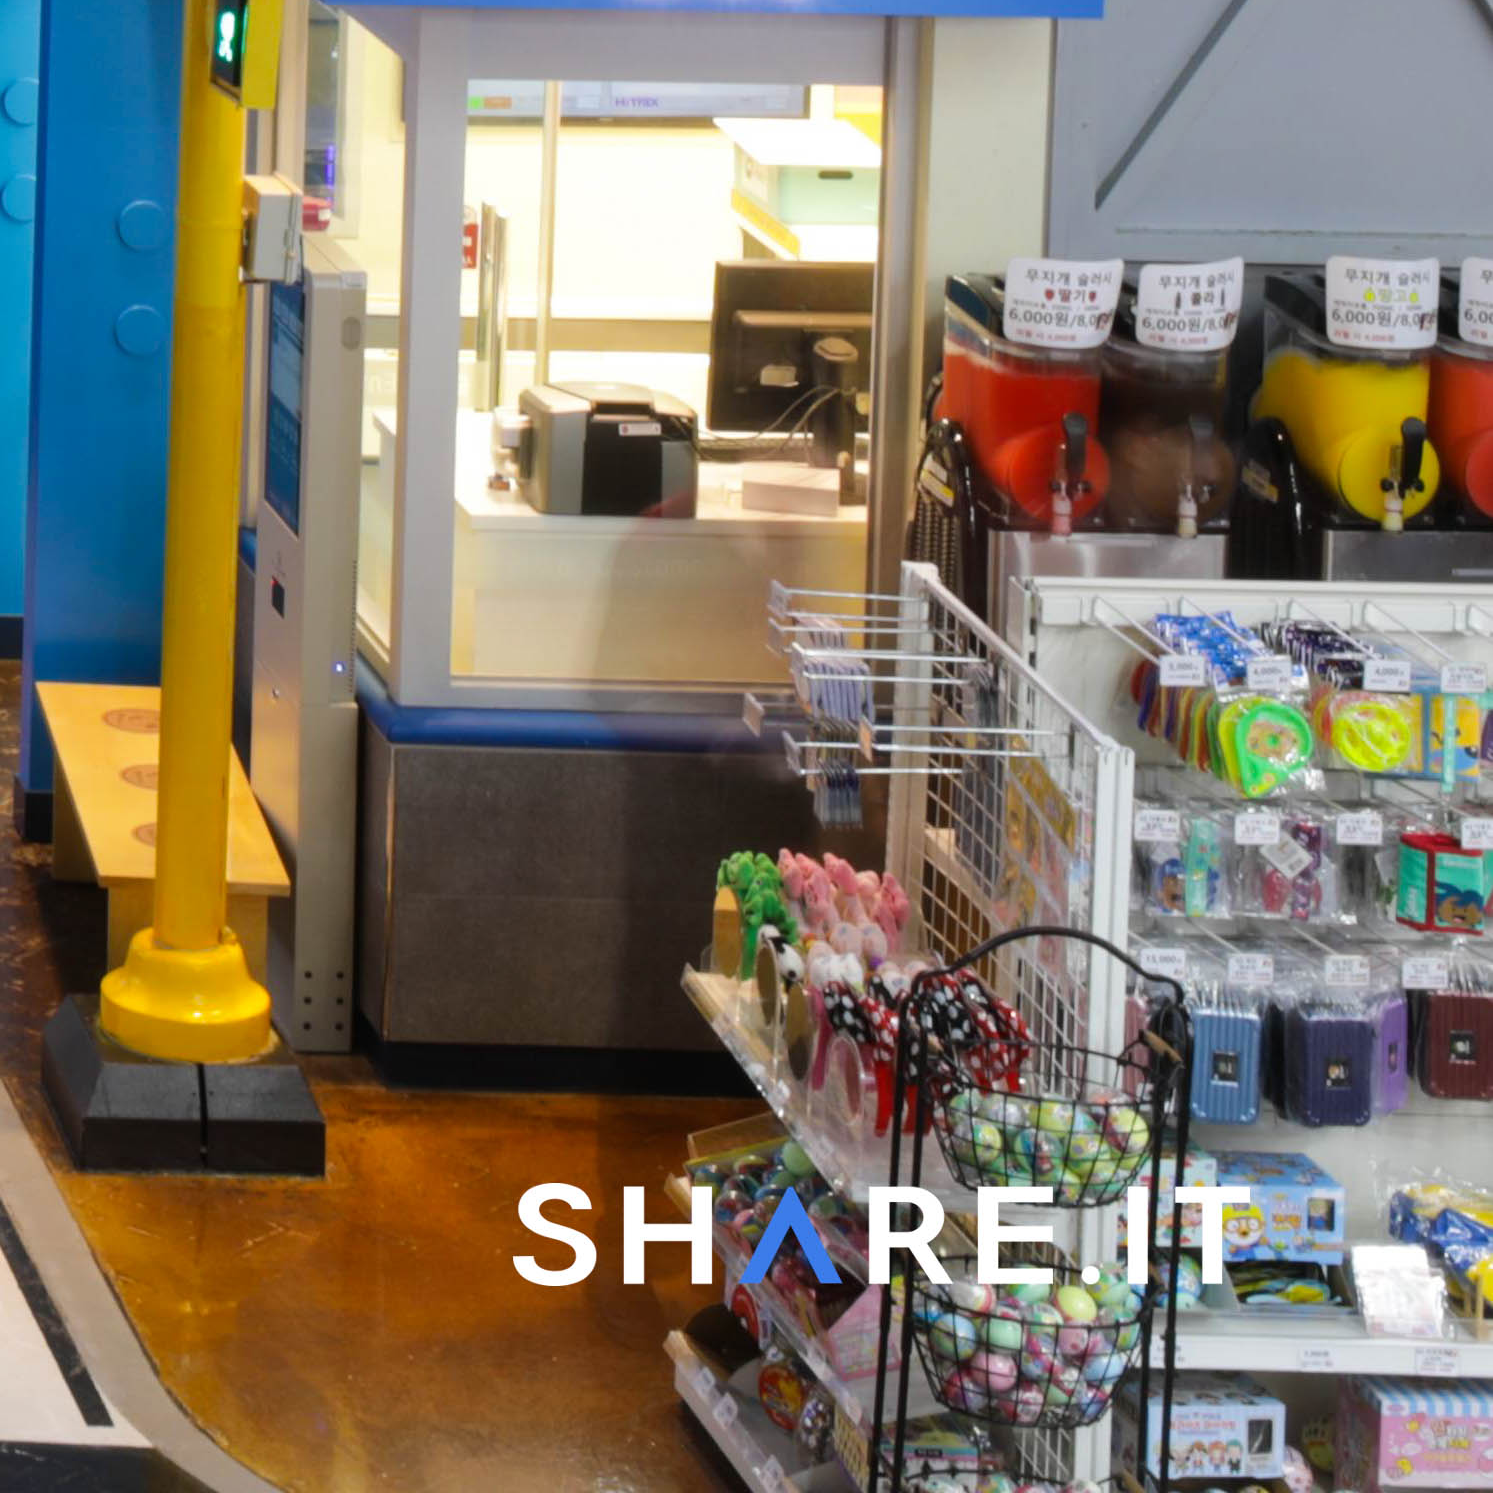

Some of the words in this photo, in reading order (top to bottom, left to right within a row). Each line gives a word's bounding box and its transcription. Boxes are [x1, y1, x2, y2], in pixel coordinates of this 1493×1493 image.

[1025, 268, 1071, 286] 무지개
[1077, 268, 1113, 287] 슬러시
[1158, 274, 1202, 289] 무지개
[1345, 268, 1390, 285] 무지개
[1058, 287, 1086, 304] 딸기
